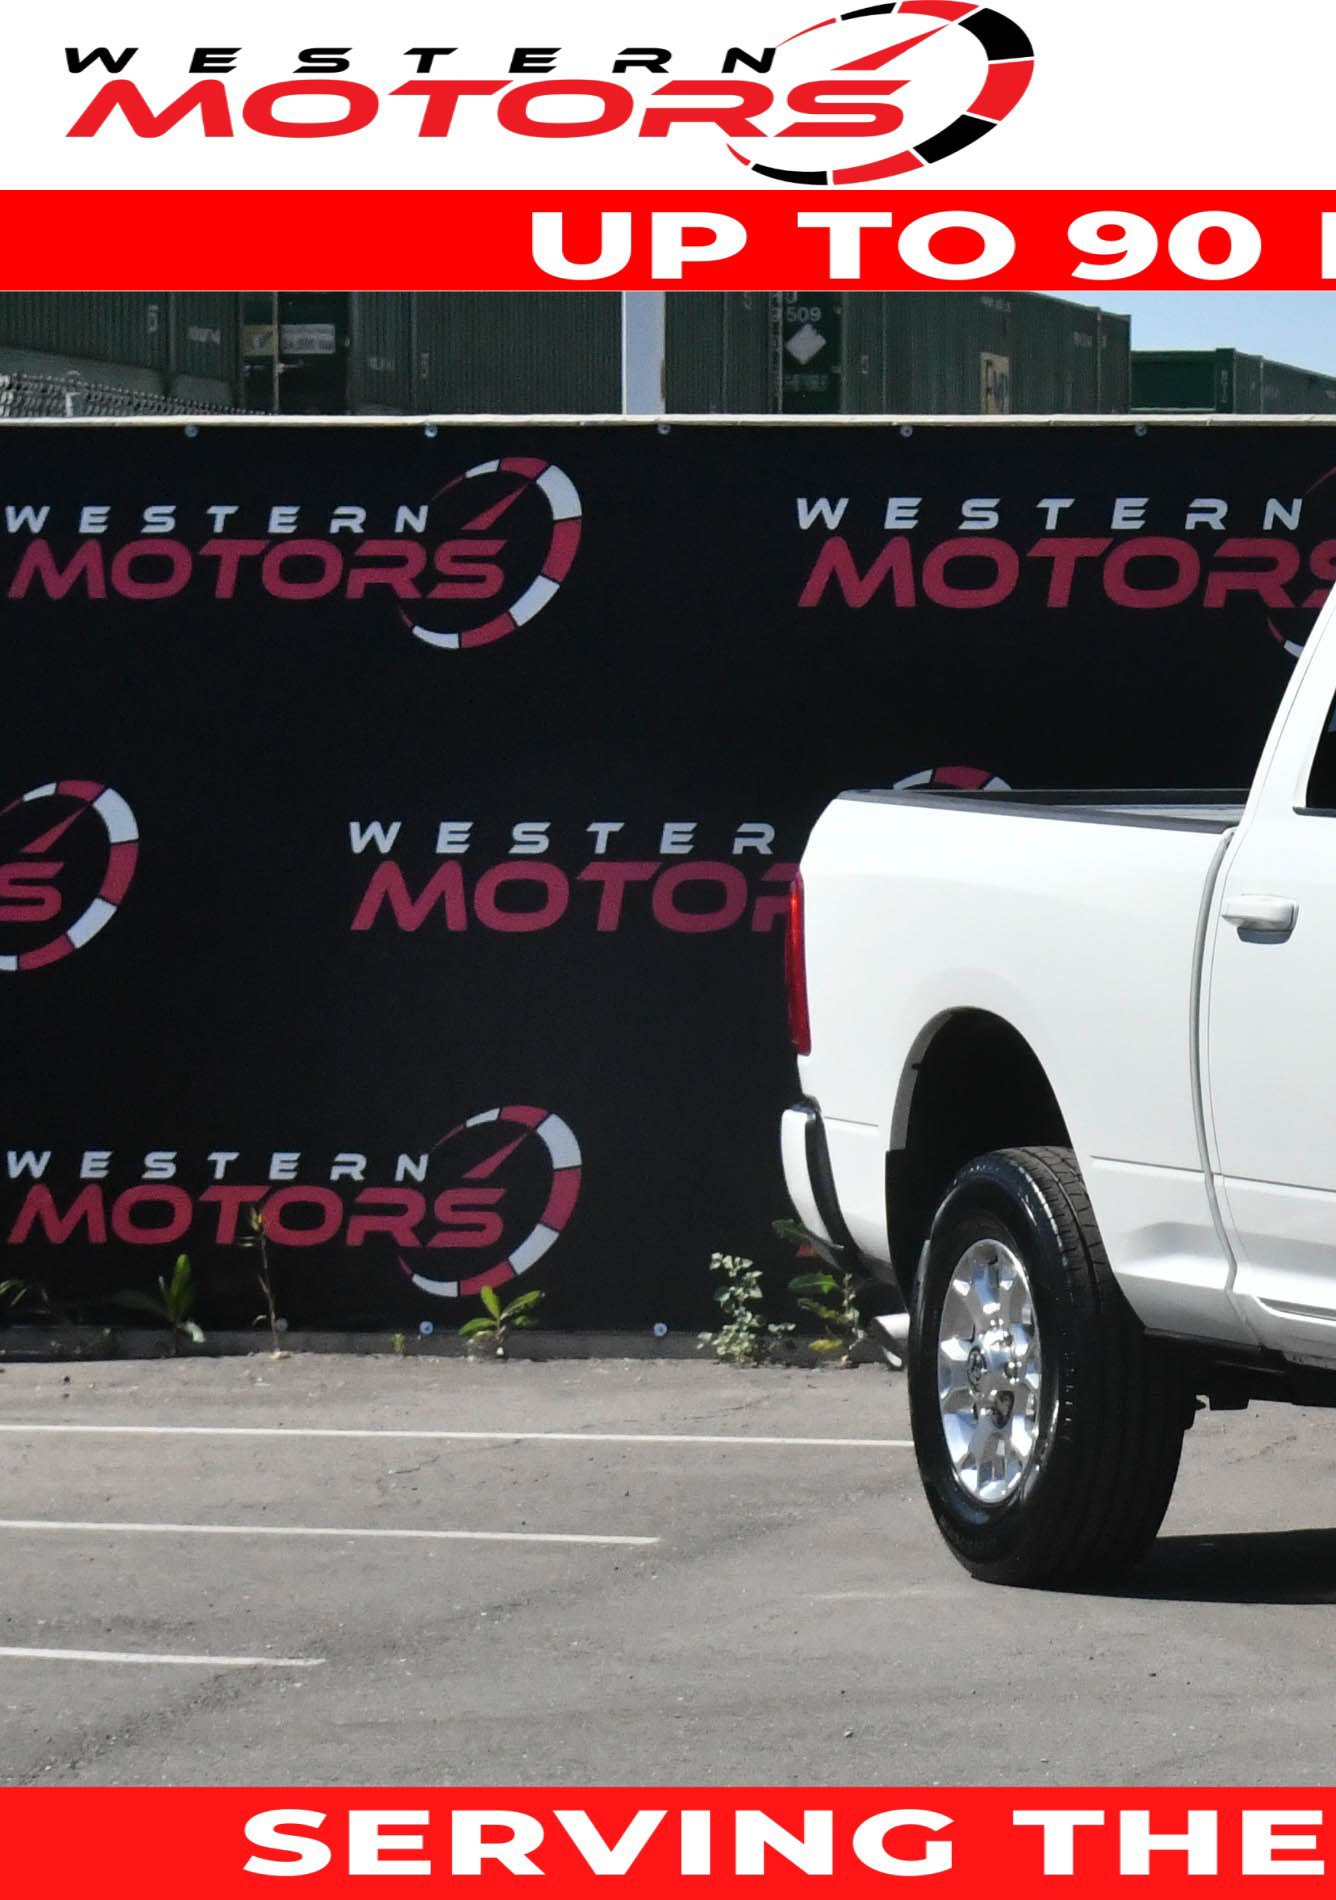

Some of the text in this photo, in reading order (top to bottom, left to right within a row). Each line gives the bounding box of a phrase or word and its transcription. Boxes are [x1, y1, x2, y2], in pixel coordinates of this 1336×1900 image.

[5, 505, 428, 534] WESTERN
[796, 497, 1303, 531] WESTERN
[8, 538, 507, 599] MOTORS
[6, 1150, 428, 1182] WESTERN
[8, 1184, 506, 1248] MOTORS
